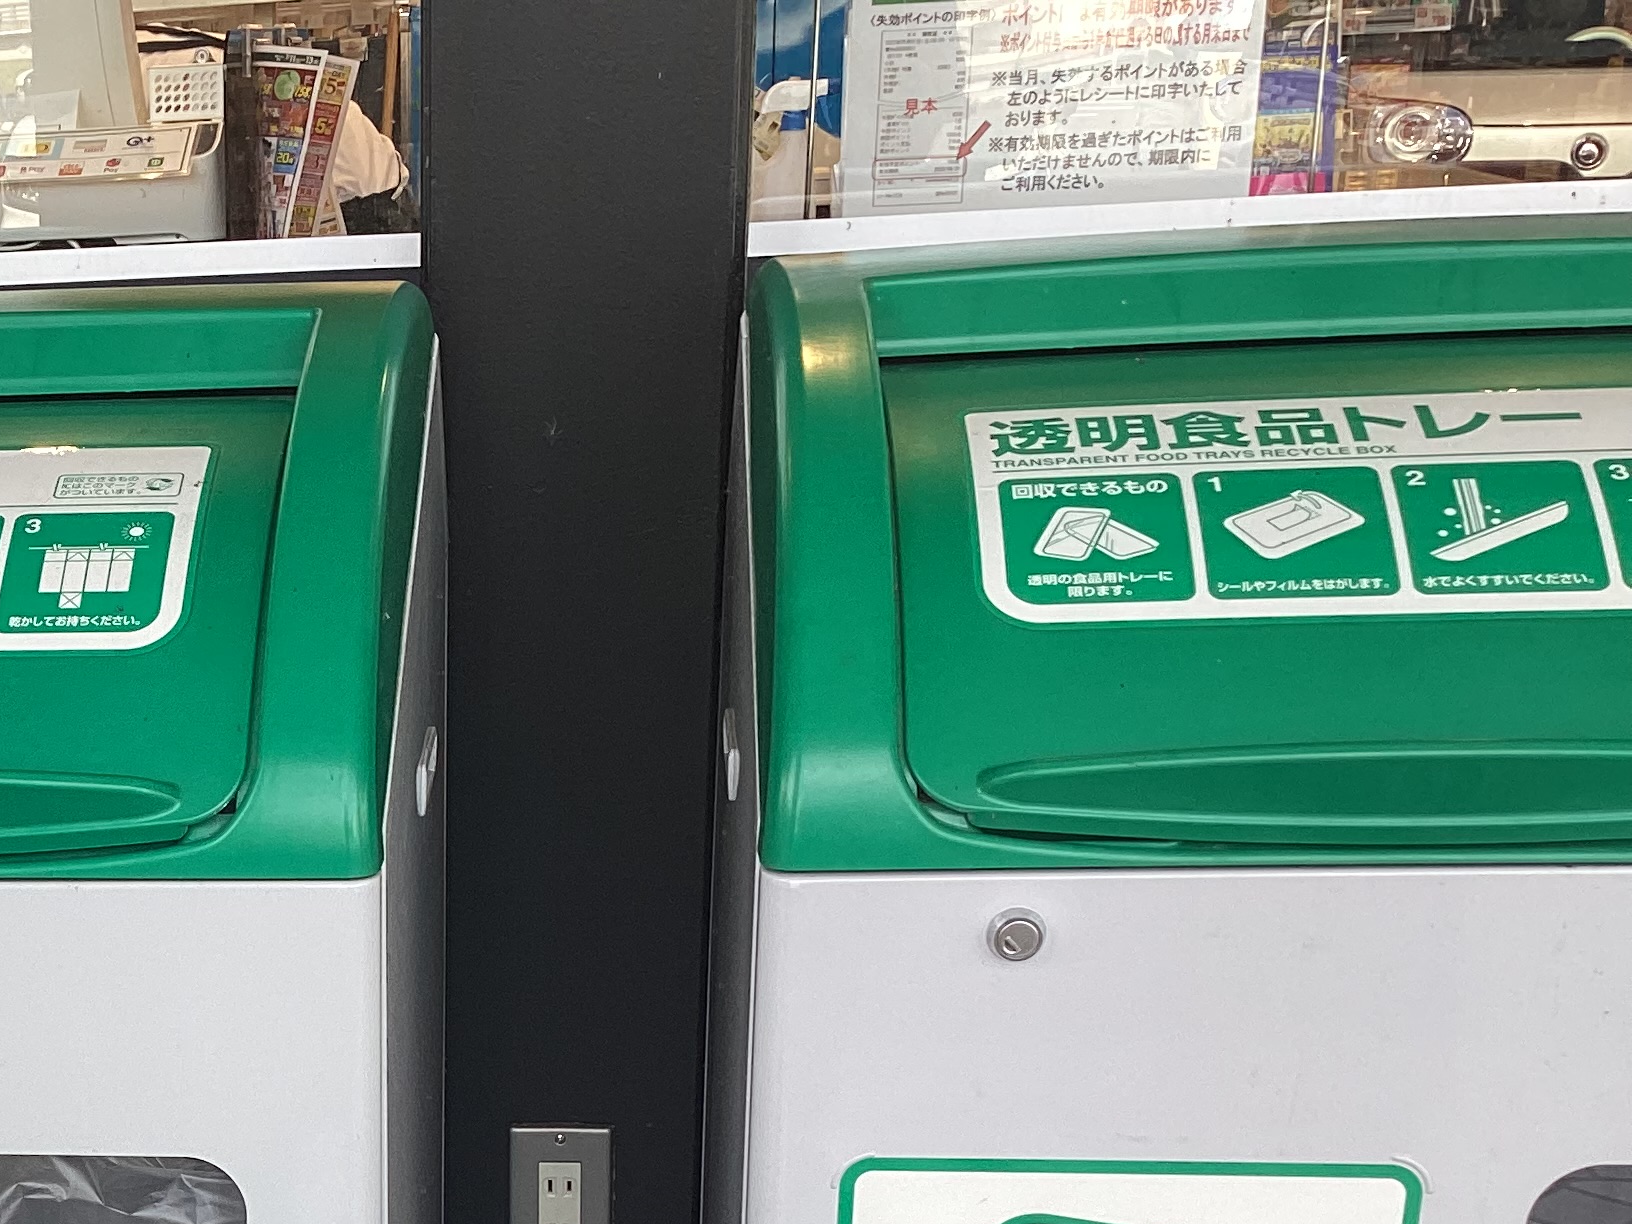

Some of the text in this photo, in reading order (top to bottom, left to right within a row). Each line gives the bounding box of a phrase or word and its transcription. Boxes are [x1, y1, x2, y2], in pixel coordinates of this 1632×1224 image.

[1007, 81, 1243, 106] 左のようにレシートに印字いたして
[904, 98, 938, 119] 見本
[1005, 111, 1068, 127] おります。
[1002, 148, 1211, 172] いただけませんので、期限内に
[1001, 173, 1105, 193] ご利用ください。
[990, 405, 1582, 457] 透明食品トレー
[992, 444, 1398, 468] TRANSPARENT FOOD TRAYS RECYCLE BOX
[1405, 471, 1426, 486] 2
[1608, 464, 1630, 480] 3
[1012, 479, 1168, 500] 回収できるもの
[1208, 476, 1222, 492] 1
[24, 518, 42, 534] 3
[1027, 571, 1173, 586] 透明の食品用トレーに
[1218, 577, 1390, 593] シールやフィルムをはがします。
[1068, 585, 1133, 598] 限ります。
[9, 615, 141, 628] 乾かしてお持ちください。
